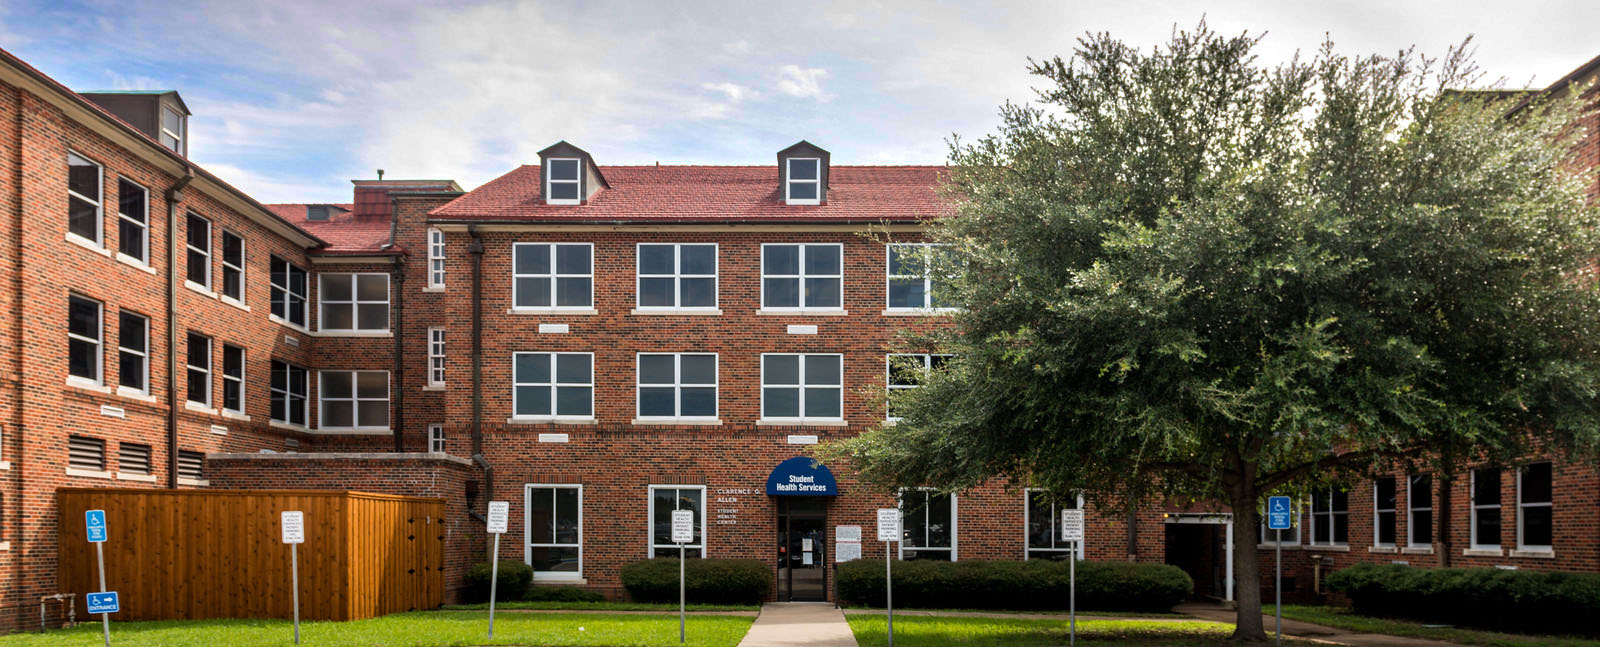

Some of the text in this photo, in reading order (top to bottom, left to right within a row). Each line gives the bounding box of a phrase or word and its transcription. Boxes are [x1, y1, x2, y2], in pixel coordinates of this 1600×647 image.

[788, 474, 814, 483] Student
[776, 483, 827, 492] Health Services
